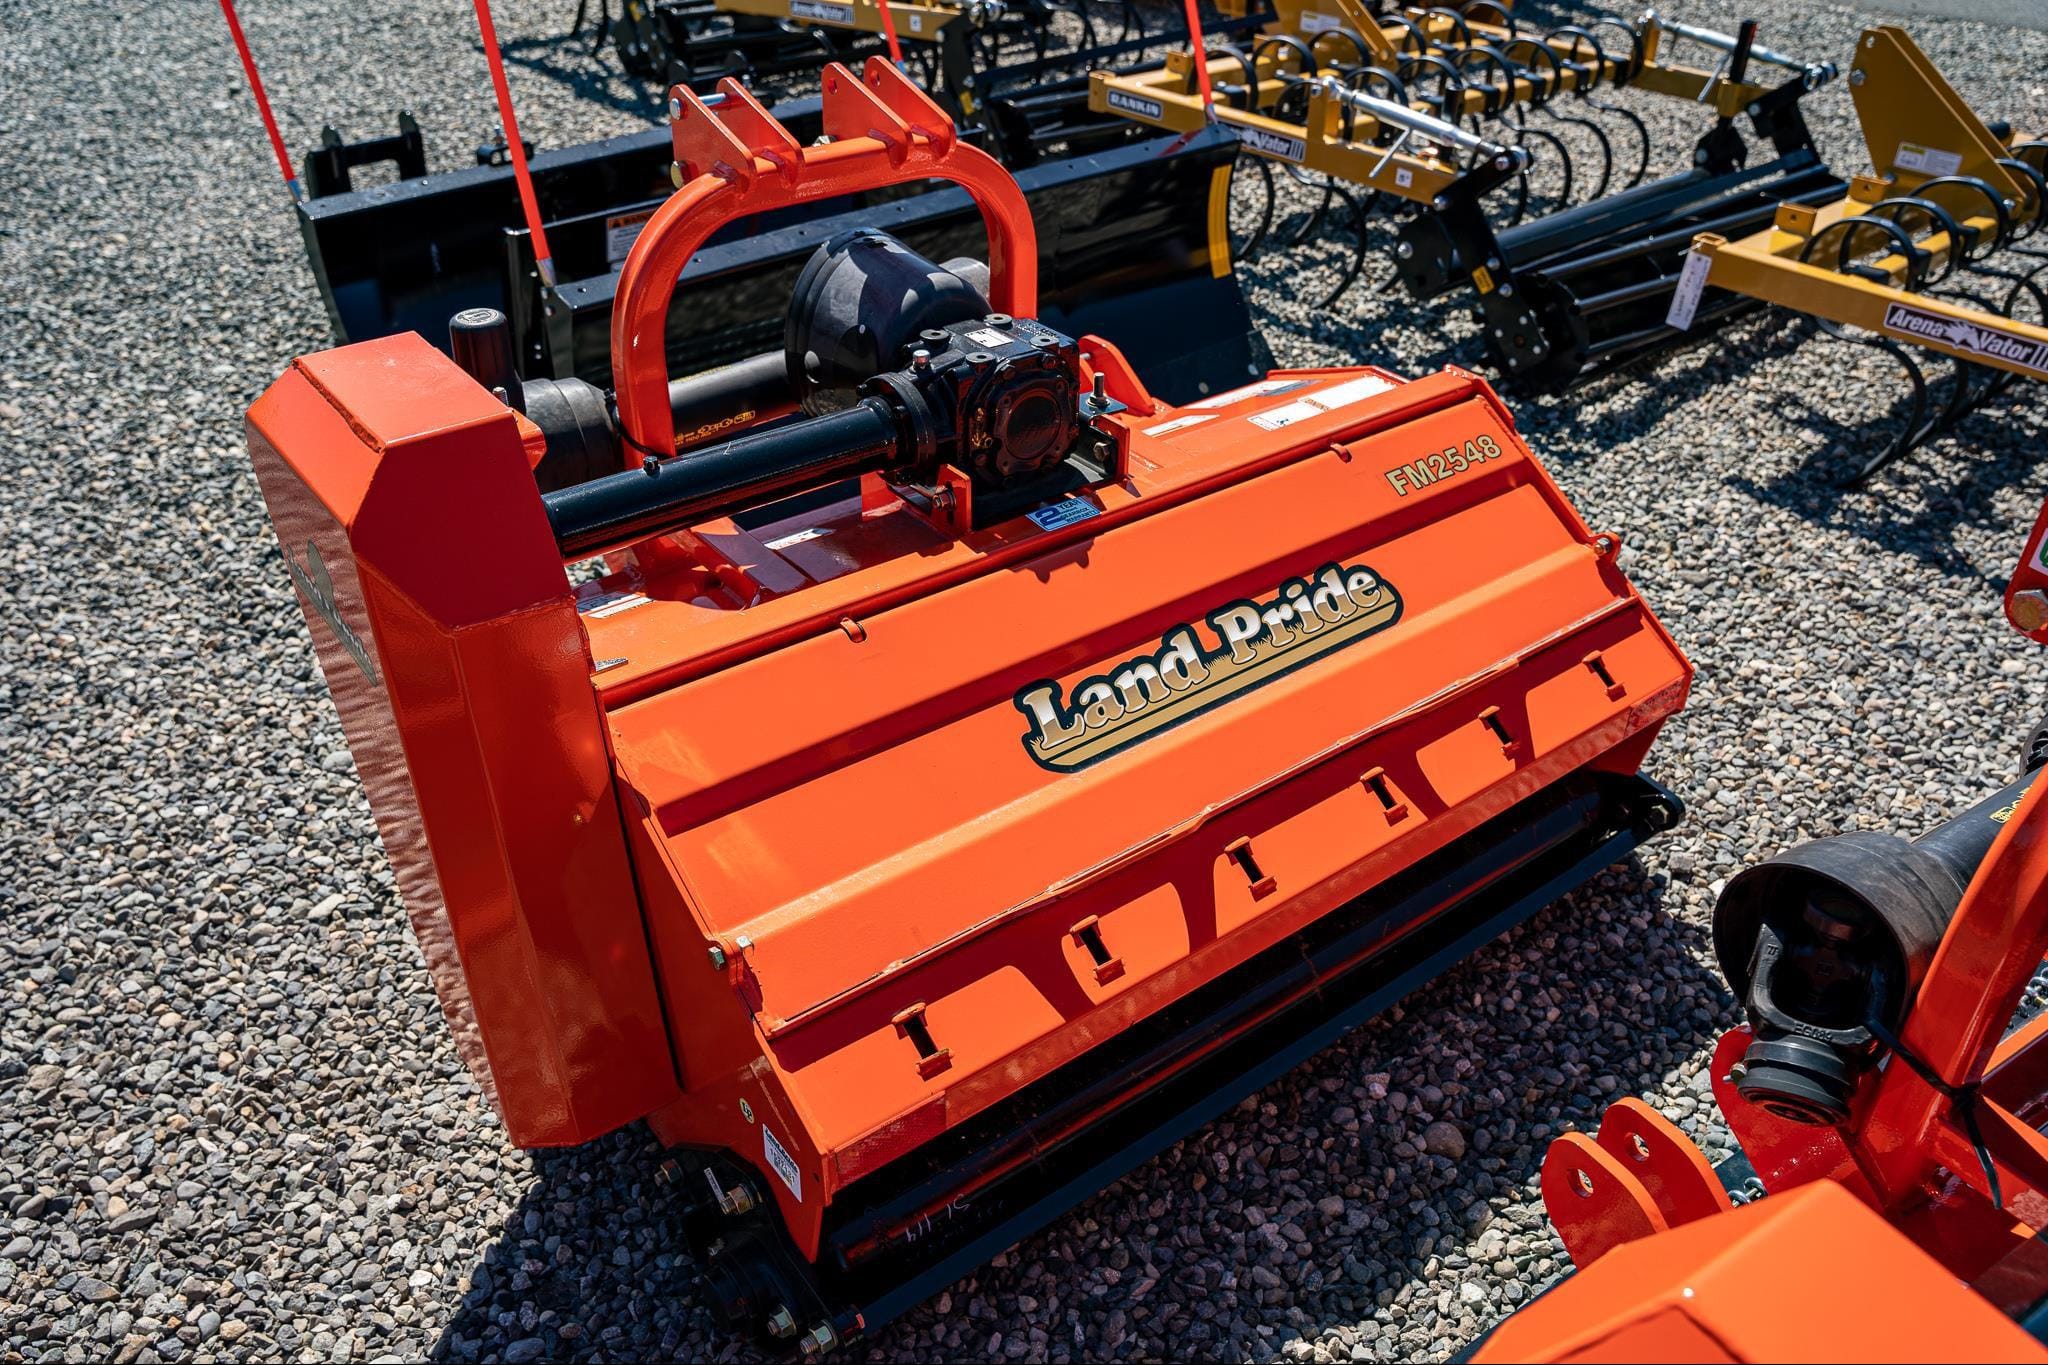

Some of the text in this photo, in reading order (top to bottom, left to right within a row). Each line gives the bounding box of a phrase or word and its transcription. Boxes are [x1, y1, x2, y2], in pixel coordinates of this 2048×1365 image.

[1108, 91, 1160, 117] RANKIN
[1889, 309, 1944, 338] Arena
[1980, 331, 2033, 360] Vator
[1384, 435, 1502, 496] FM2548
[1023, 567, 1384, 751] Land Pride
